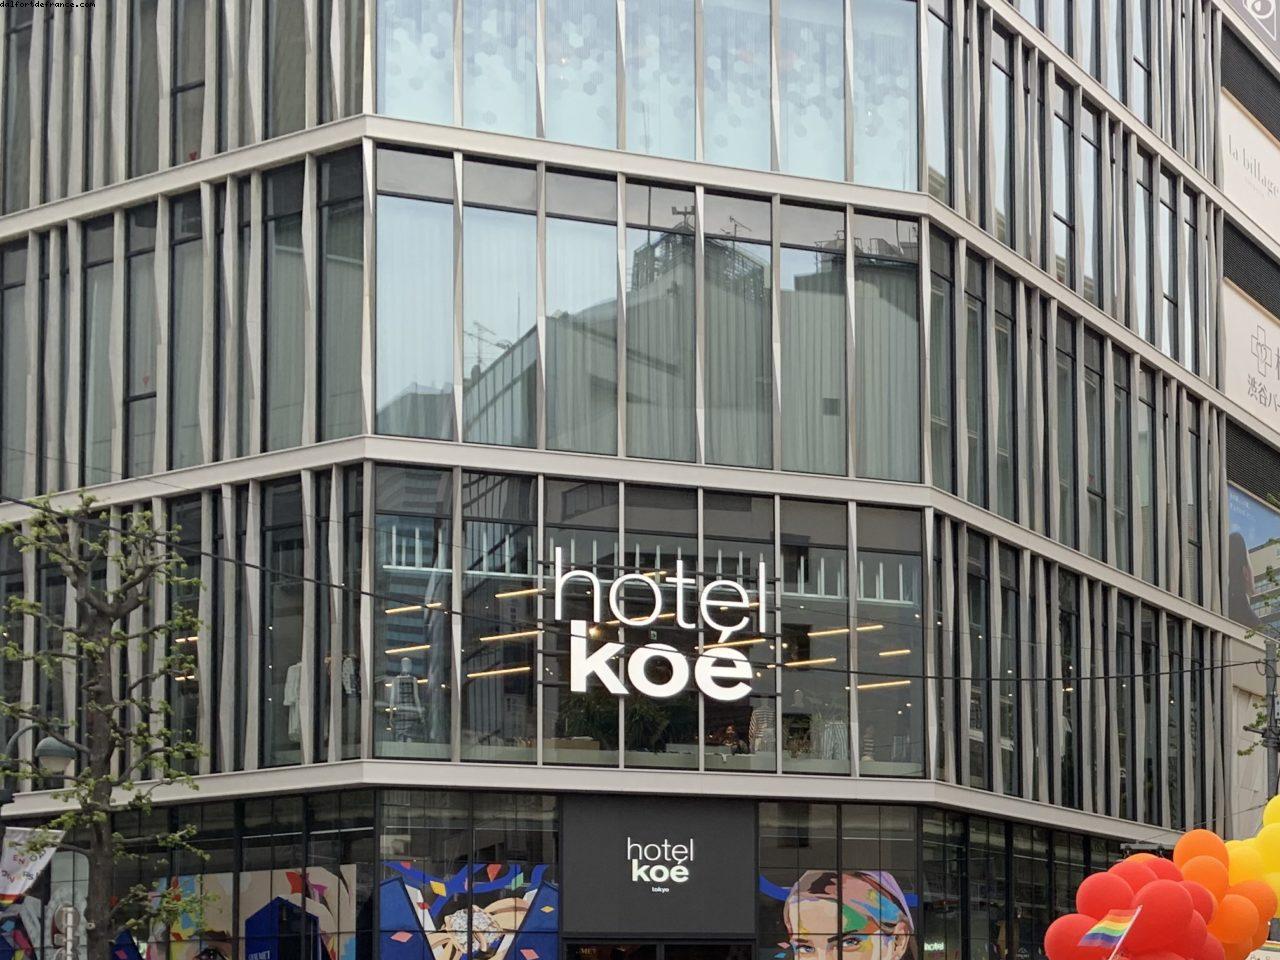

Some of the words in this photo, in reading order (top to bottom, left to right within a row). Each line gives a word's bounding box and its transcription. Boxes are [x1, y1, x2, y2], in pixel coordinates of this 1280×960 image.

[554, 546, 766, 636] hotel
[627, 836, 694, 865] hotel
[924, 942, 944, 951] hotel
